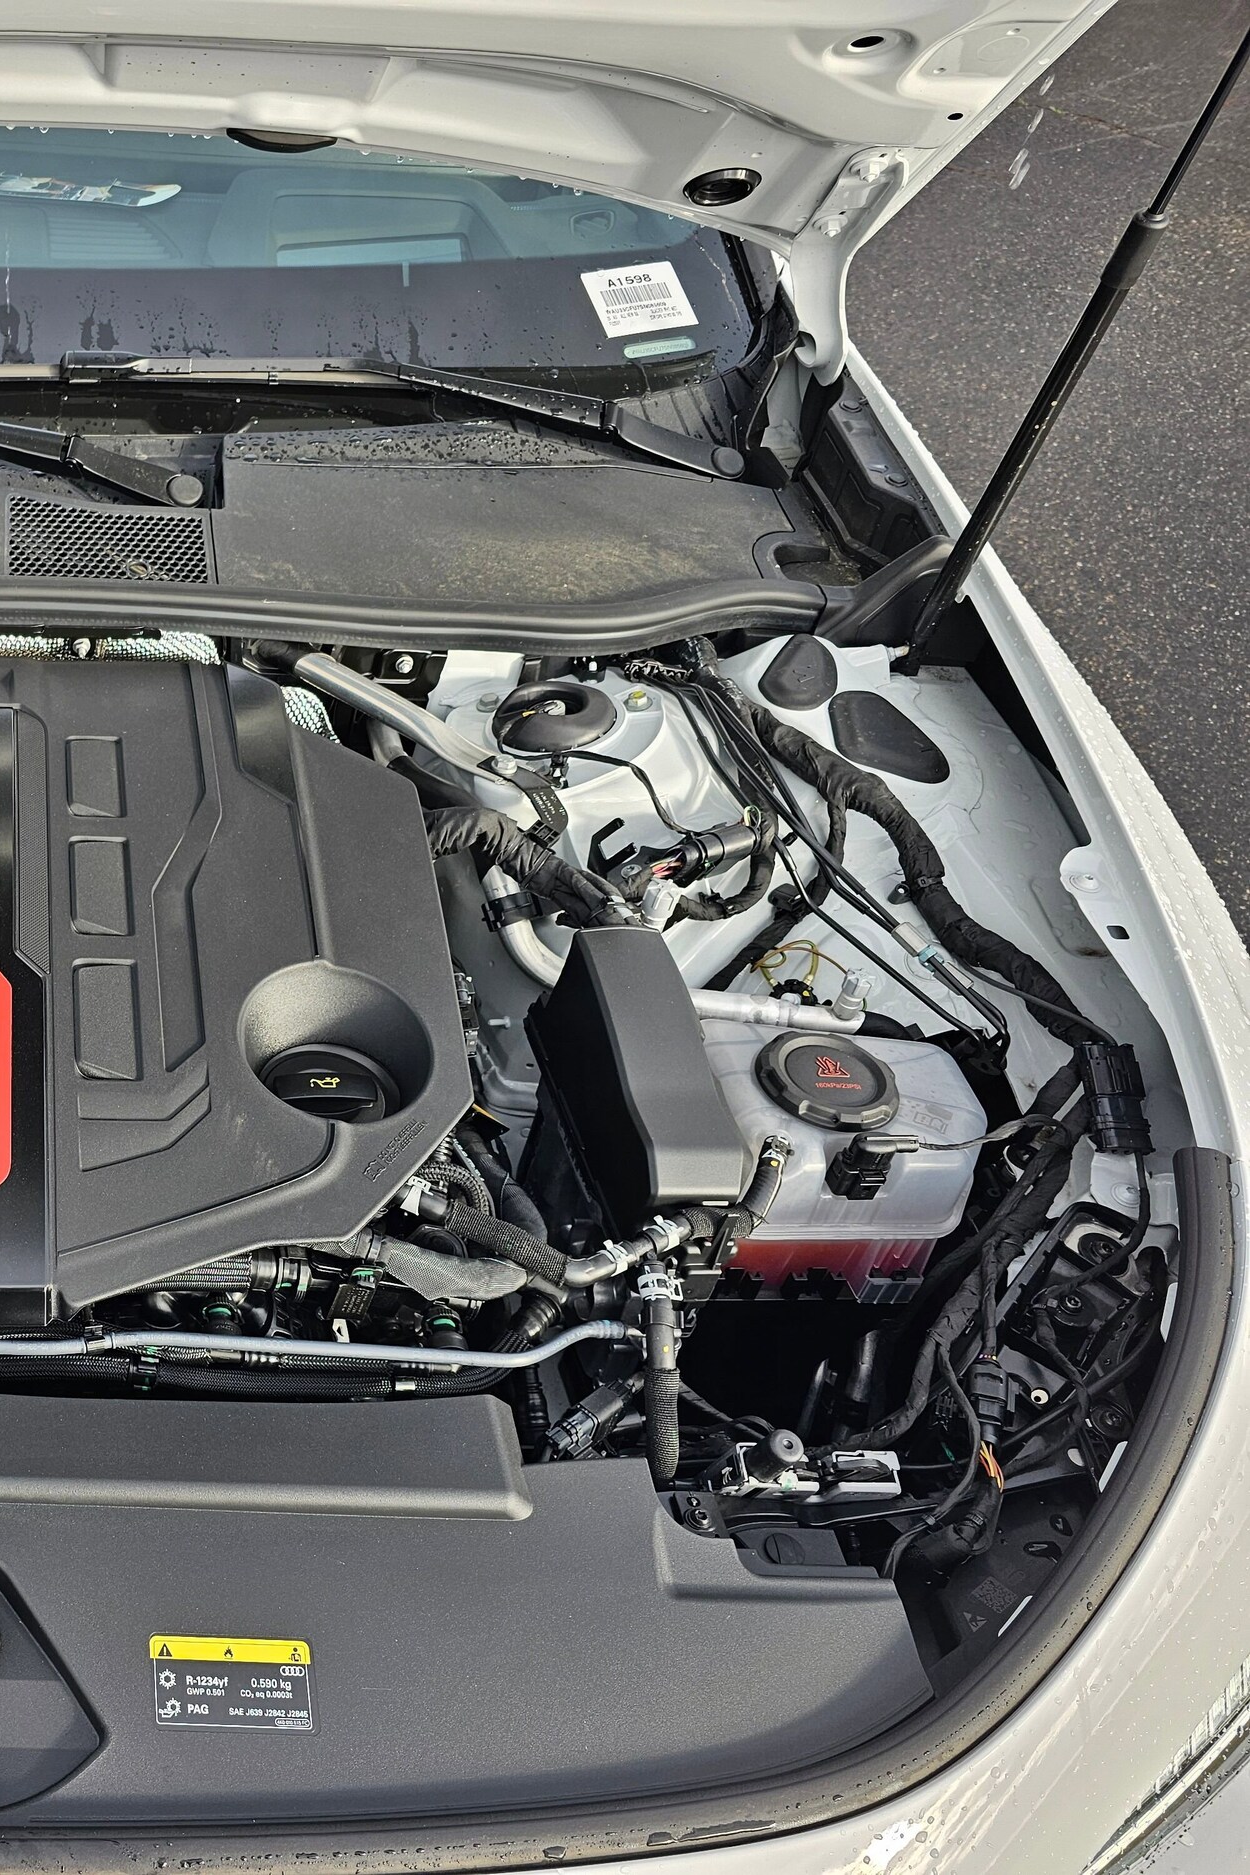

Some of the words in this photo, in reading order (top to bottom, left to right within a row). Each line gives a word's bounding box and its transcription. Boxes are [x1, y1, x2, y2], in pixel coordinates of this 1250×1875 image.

[608, 273, 652, 288] A1598
[185, 1675, 228, 1688] R-1234yf
[251, 1678, 277, 1688] 0.590
[280, 1679, 292, 1691] kg
[206, 1688, 225, 1696] 0.501
[255, 1691, 265, 1699] eq
[266, 1690, 293, 1699] 0.0003t
[187, 1703, 209, 1714] PAG
[229, 1707, 244, 1716] SAE
[245, 1708, 263, 1716] J639
[264, 1708, 286, 1717] J2842
[286, 1709, 309, 1718] J2845
